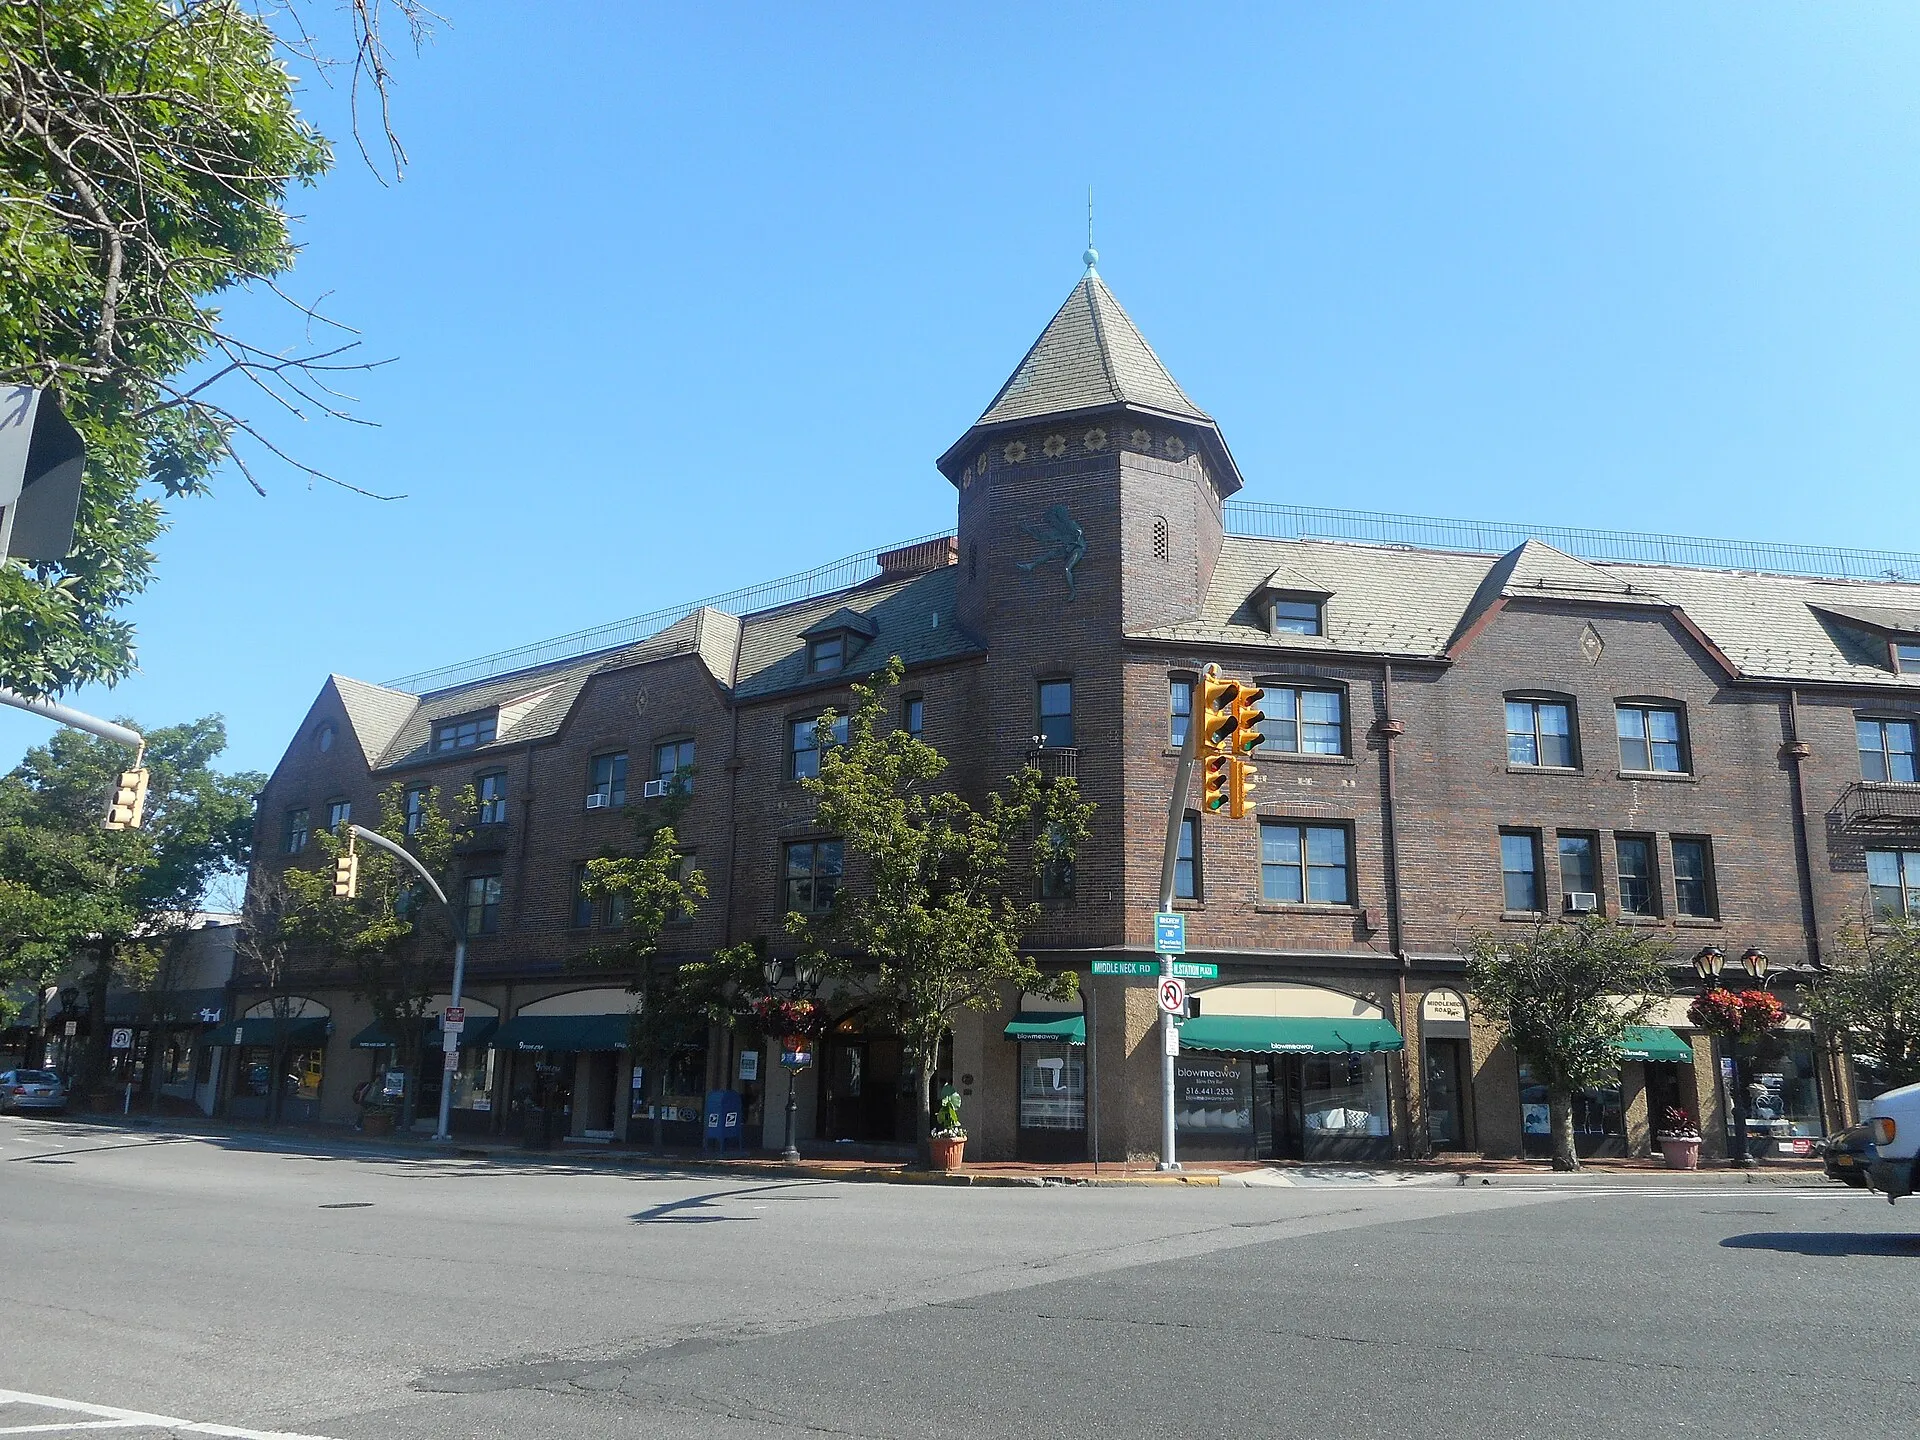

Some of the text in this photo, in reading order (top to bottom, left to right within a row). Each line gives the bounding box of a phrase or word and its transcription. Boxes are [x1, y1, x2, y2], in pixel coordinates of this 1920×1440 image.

[1094, 962, 1150, 974] MIDDLE NECK RD
[1200, 966, 1212, 975] PLAZA
[1270, 1042, 1314, 1050] blowmeaway
[1177, 1067, 1240, 1079] blowmeaway
[1186, 1087, 1234, 1095] 516.441.2533
